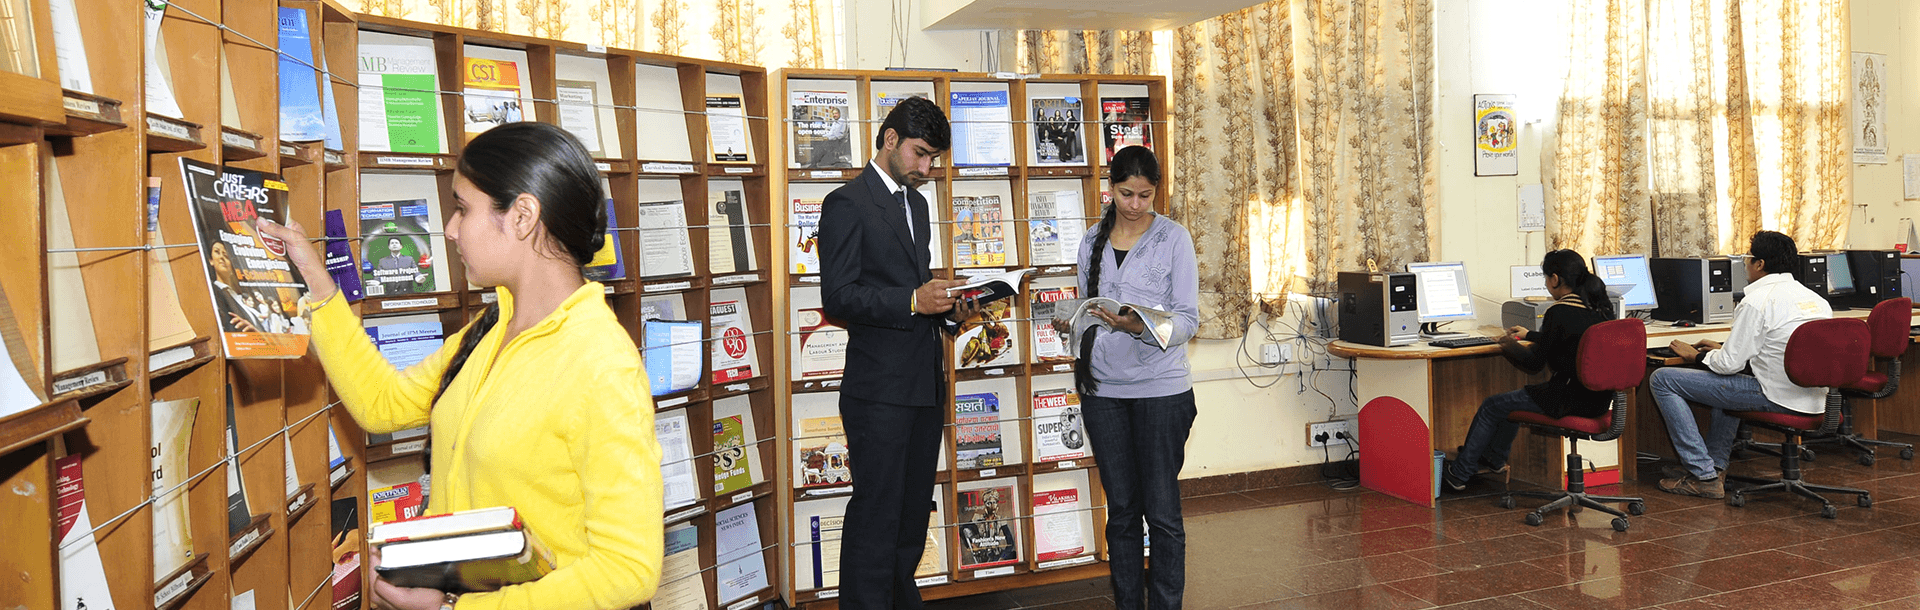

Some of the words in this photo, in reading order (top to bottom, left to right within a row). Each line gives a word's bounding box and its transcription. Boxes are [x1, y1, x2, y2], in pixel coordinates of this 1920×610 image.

[387, 57, 431, 67] Management
[392, 64, 426, 73] Review
[471, 63, 497, 81] CSI
[804, 94, 847, 105] Enterprise
[1110, 124, 1143, 135] Steel
[391, 157, 418, 165] Management
[220, 172, 245, 185] JUST
[213, 180, 269, 204] CAREERS
[952, 197, 1000, 206] competition
[219, 199, 258, 222] MBA
[676, 206, 687, 246] ECONOMICS
[680, 246, 690, 271] LABOUR
[373, 269, 399, 277] Software
[399, 266, 419, 275] Project
[380, 275, 414, 283] Management
[381, 331, 399, 339] Journal
[84, 375, 100, 384] Review
[1035, 399, 1047, 408] THE
[1046, 396, 1067, 407] WEEK
[1037, 422, 1063, 435] SUPER
[730, 467, 746, 476] Funds
[964, 489, 1006, 507] TIE
[729, 512, 748, 521] SCIENCES
[731, 520, 745, 529] INDEX
